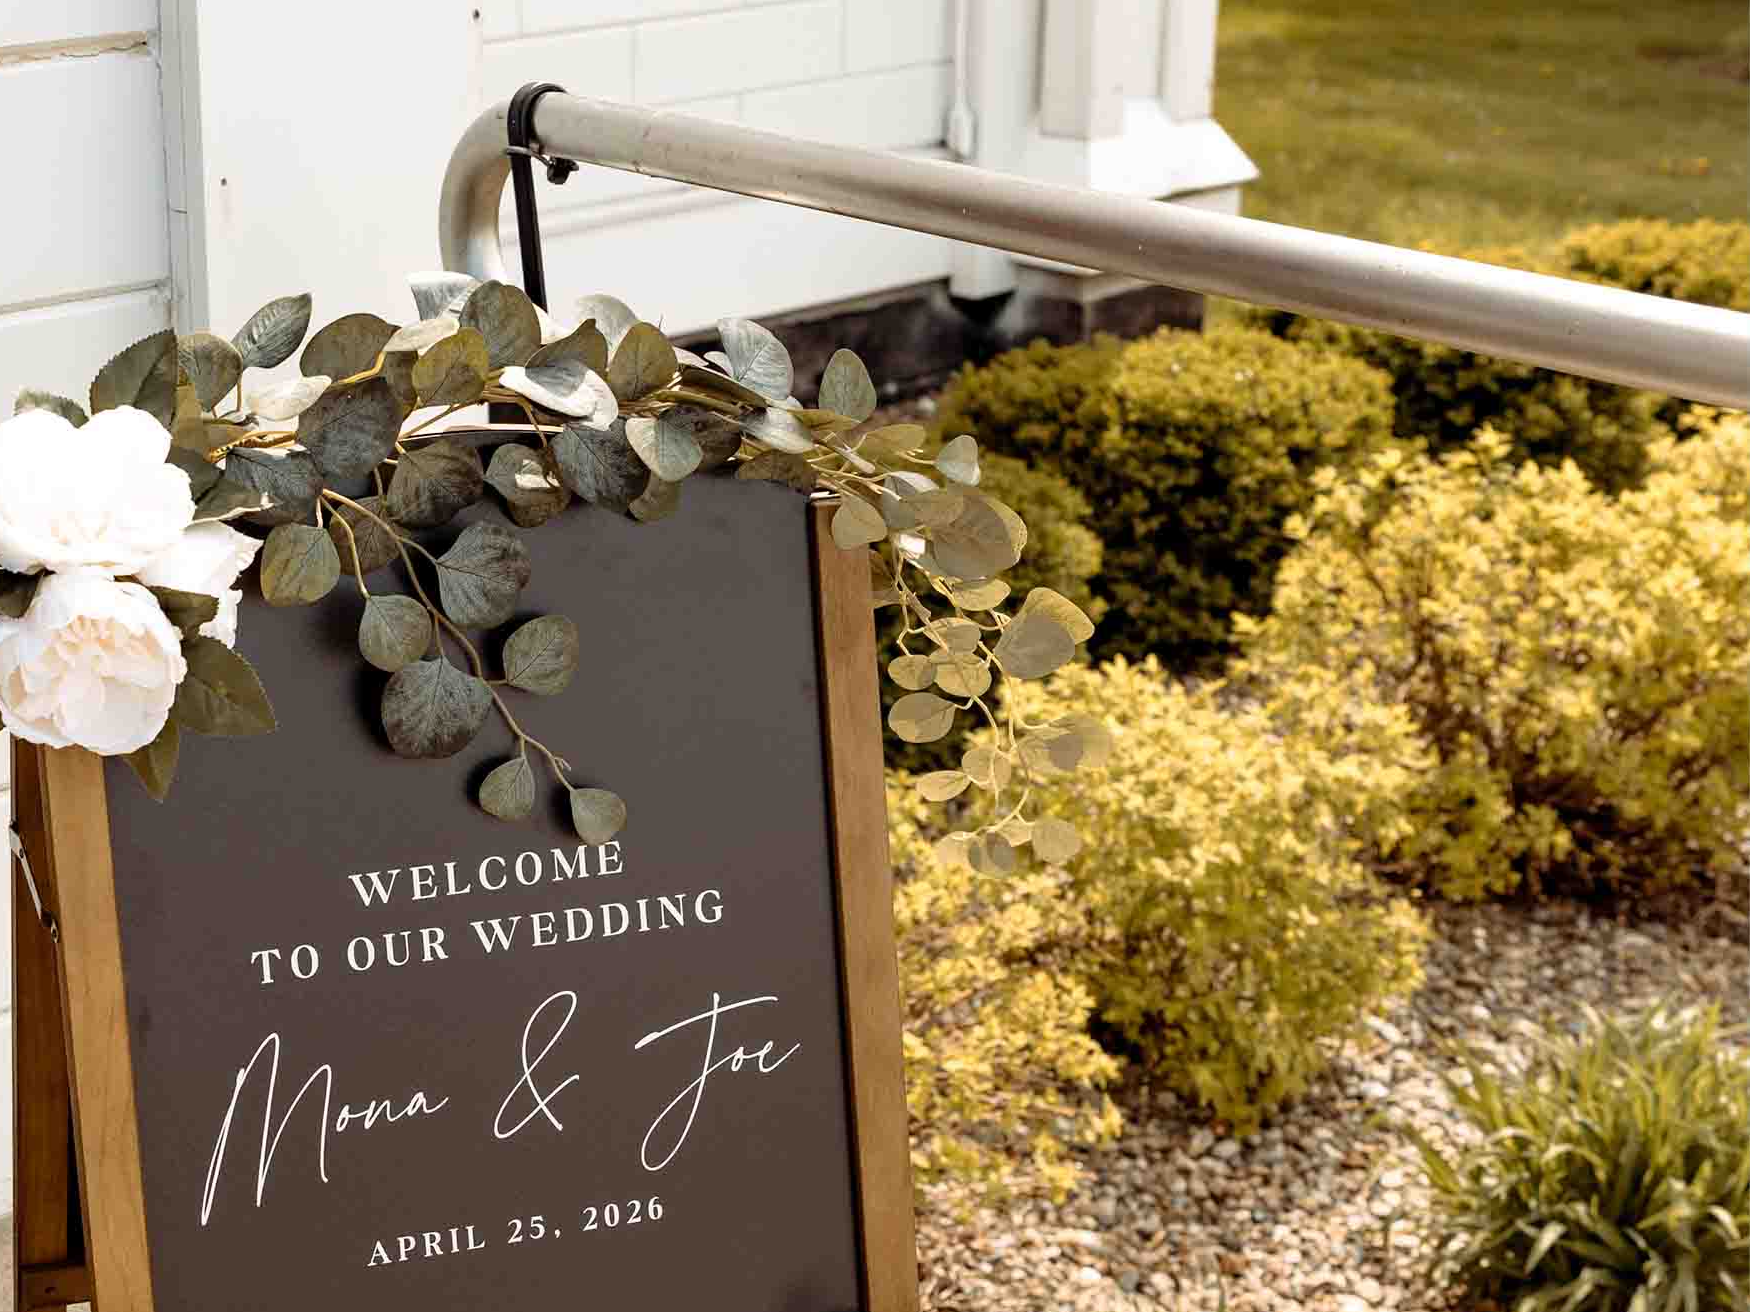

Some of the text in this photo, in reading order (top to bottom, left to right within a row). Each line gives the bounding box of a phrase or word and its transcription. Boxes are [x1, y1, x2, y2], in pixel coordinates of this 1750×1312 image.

[347, 839, 624, 907] WELCOME
[250, 889, 725, 984] TO OUR WEDDING
[200, 989, 801, 1227] Mona & Joe
[366, 1196, 663, 1268] APRIL 25, 2026
